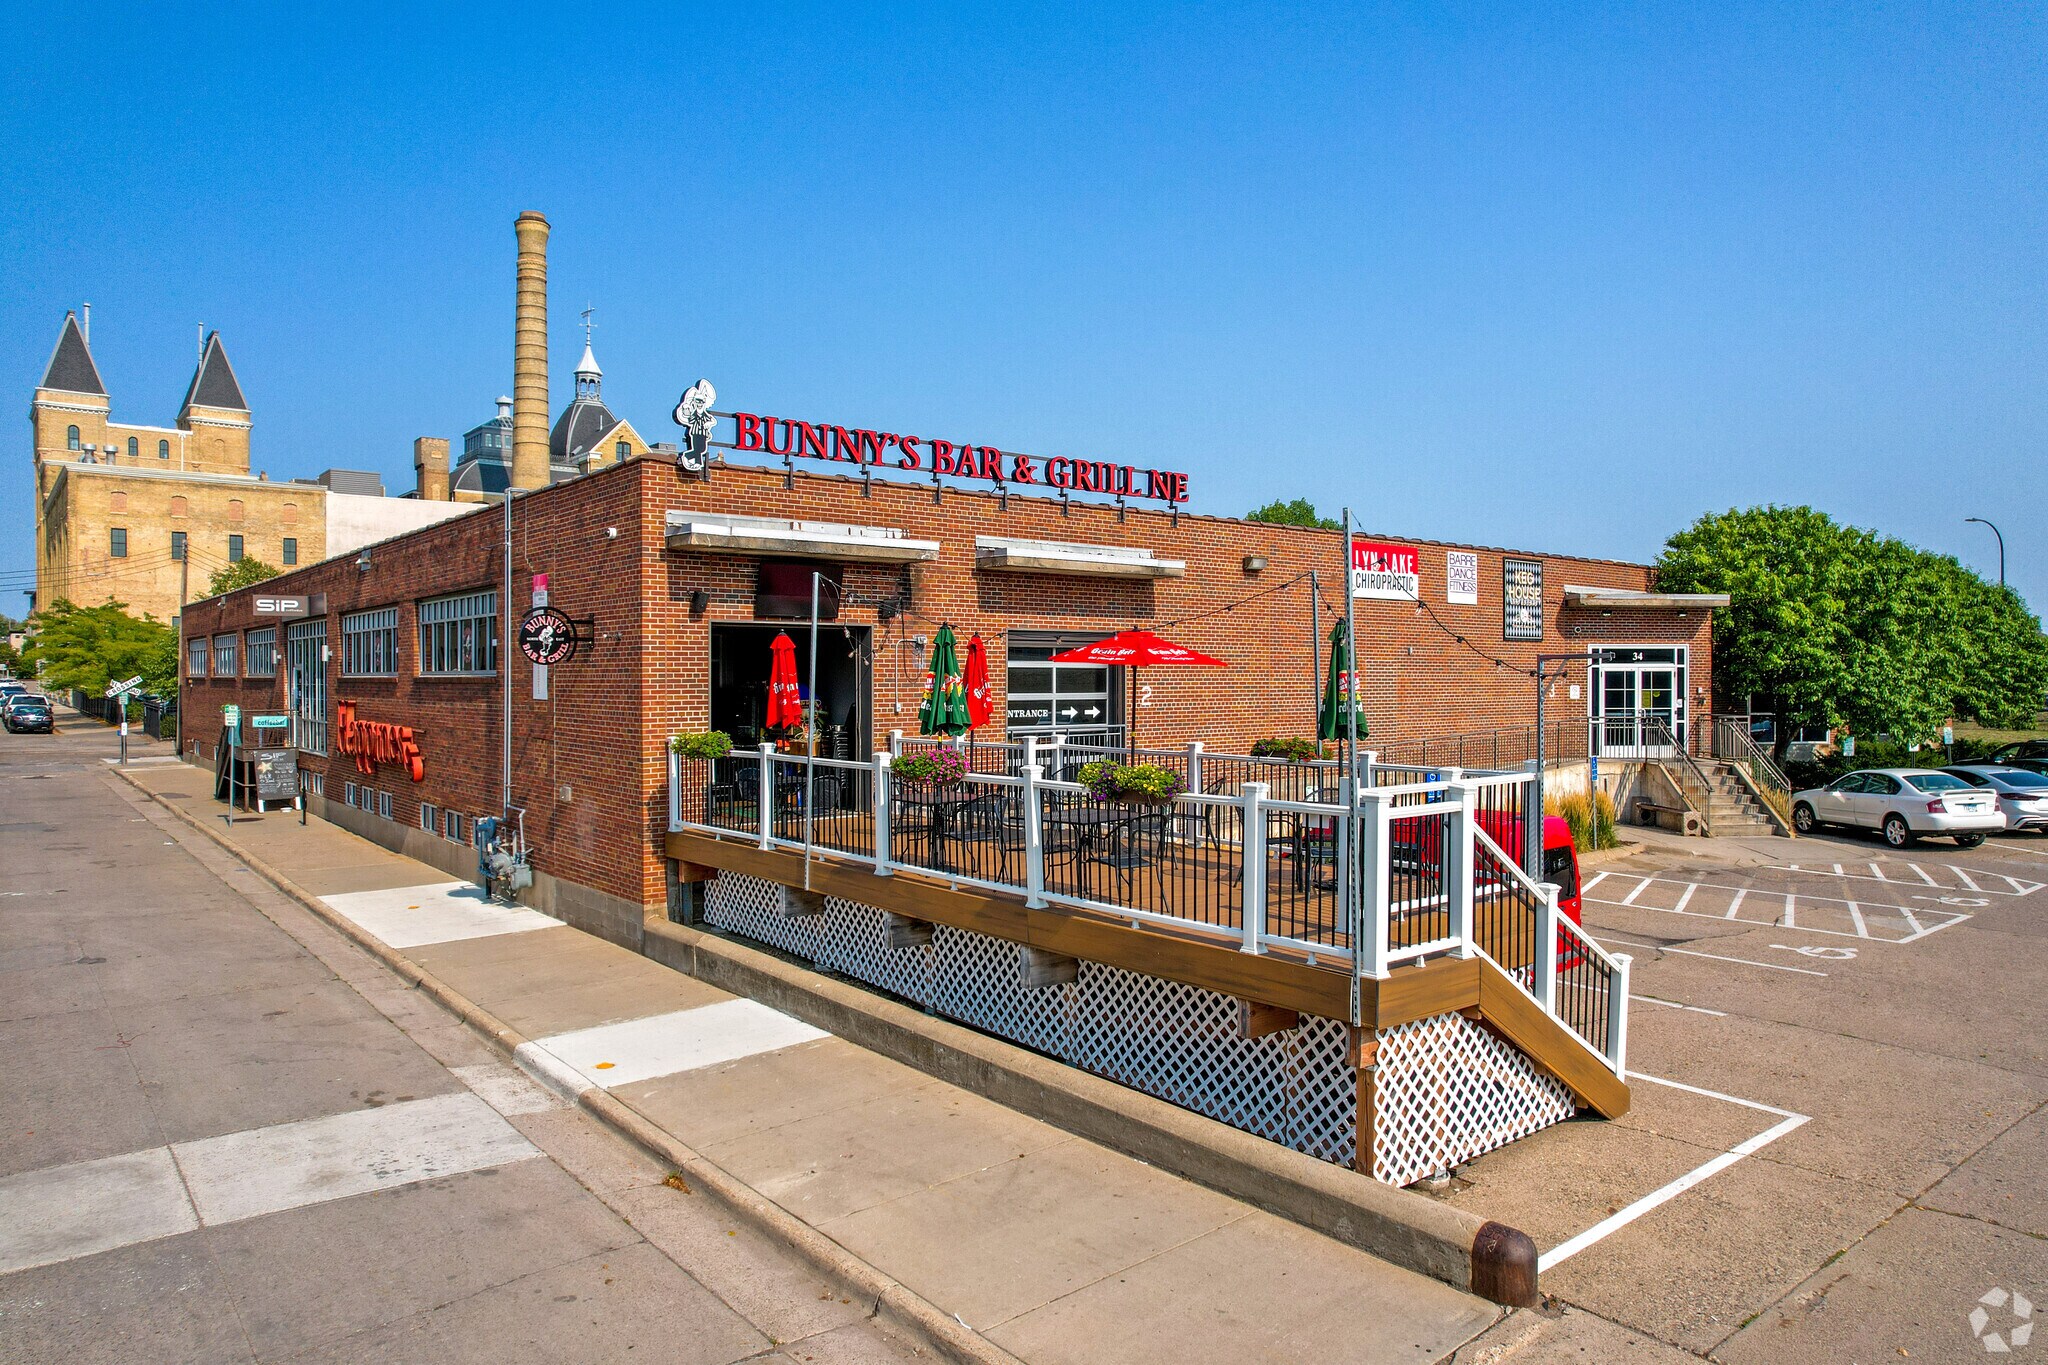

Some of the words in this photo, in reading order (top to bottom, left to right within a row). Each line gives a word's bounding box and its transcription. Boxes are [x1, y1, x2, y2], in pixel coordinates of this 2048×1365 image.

[735, 412, 920, 470] BUNNY'S
[932, 439, 1005, 481] BAR
[1013, 455, 1037, 484] &
[1046, 455, 1142, 497] GRILL
[1148, 469, 1189, 503] NE
[1383, 552, 1414, 574] LAKE
[1449, 553, 1476, 567] BARRE
[1449, 567, 1476, 580] DANCE
[1515, 570, 1535, 585] KEG
[1355, 572, 1414, 592] CHIROPRACTIC
[1449, 581, 1477, 593] FITNESS
[1509, 586, 1541, 600] HOUSE
[525, 615, 566, 634] BUNNY'S
[522, 643, 539, 661] BAR
[538, 655, 546, 664] &
[547, 642, 569, 663] GRILL
[1632, 652, 1644, 661] 34
[107, 677, 141, 695] CROSSING
[1141, 685, 1152, 706] 2
[1007, 709, 1048, 718] NTRANCE
